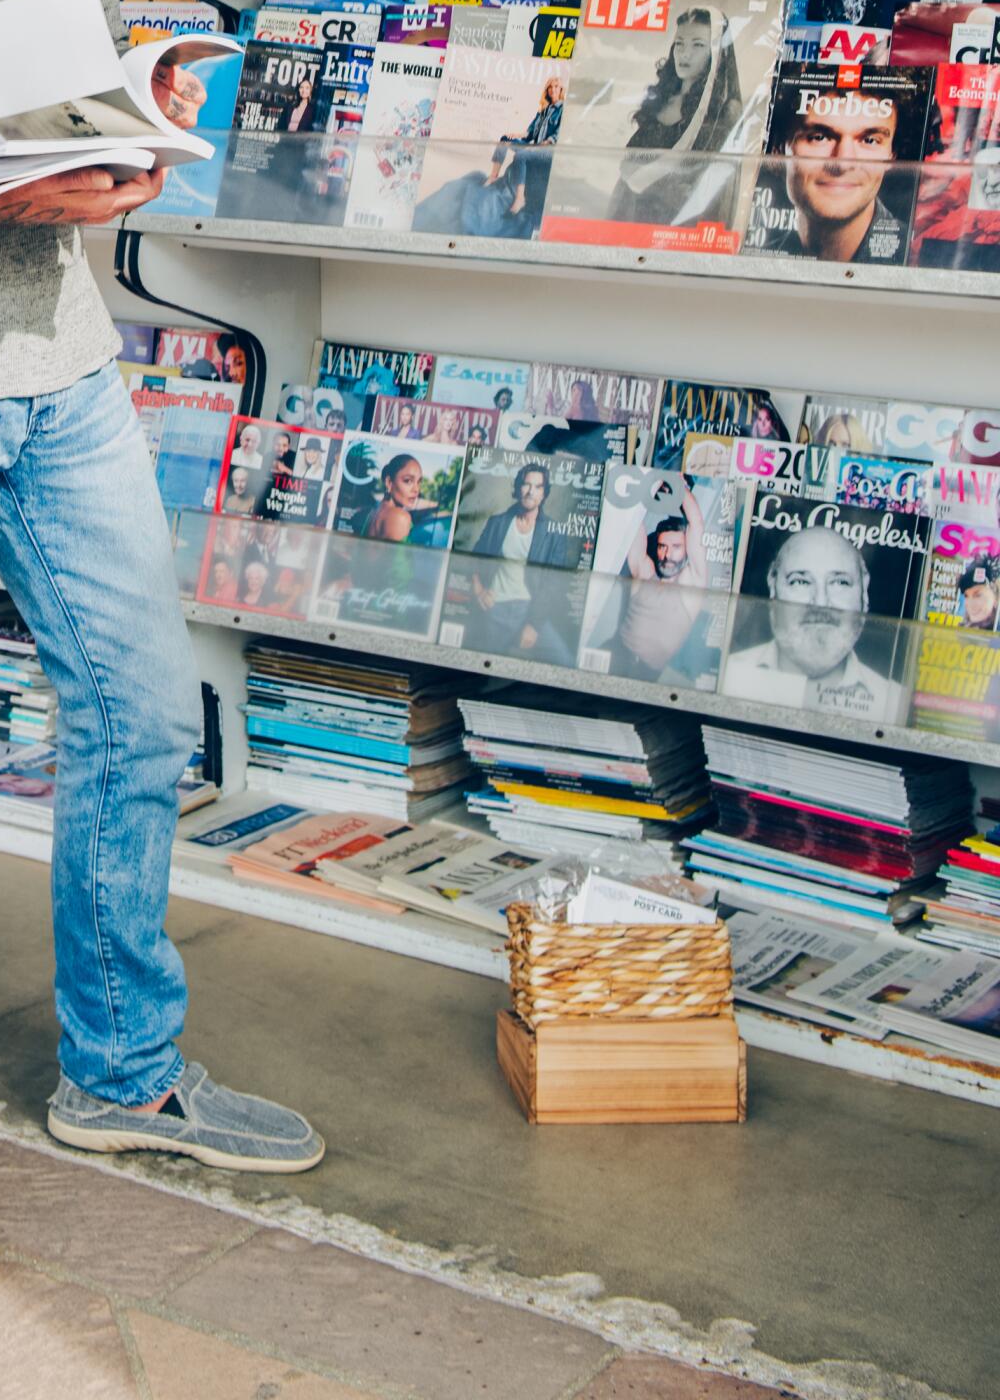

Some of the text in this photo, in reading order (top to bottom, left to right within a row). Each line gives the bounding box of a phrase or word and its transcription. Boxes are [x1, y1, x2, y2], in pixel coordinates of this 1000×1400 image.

[322, 19, 357, 42] CR
[381, 61, 443, 79] THE WORLD
[245, 102, 263, 116] THE
[796, 88, 893, 119] Forbes
[702, 226, 716, 244] 10
[327, 345, 428, 385] VANITY FAIR
[736, 441, 775, 477] Us
[274, 475, 307, 491] TIME
[271, 488, 307, 504] People
[266, 498, 307, 515] We Lost
[567, 512, 599, 528] JASON
[751, 495, 929, 556] Los Angeles
[633, 899, 684, 922] POST CARD
